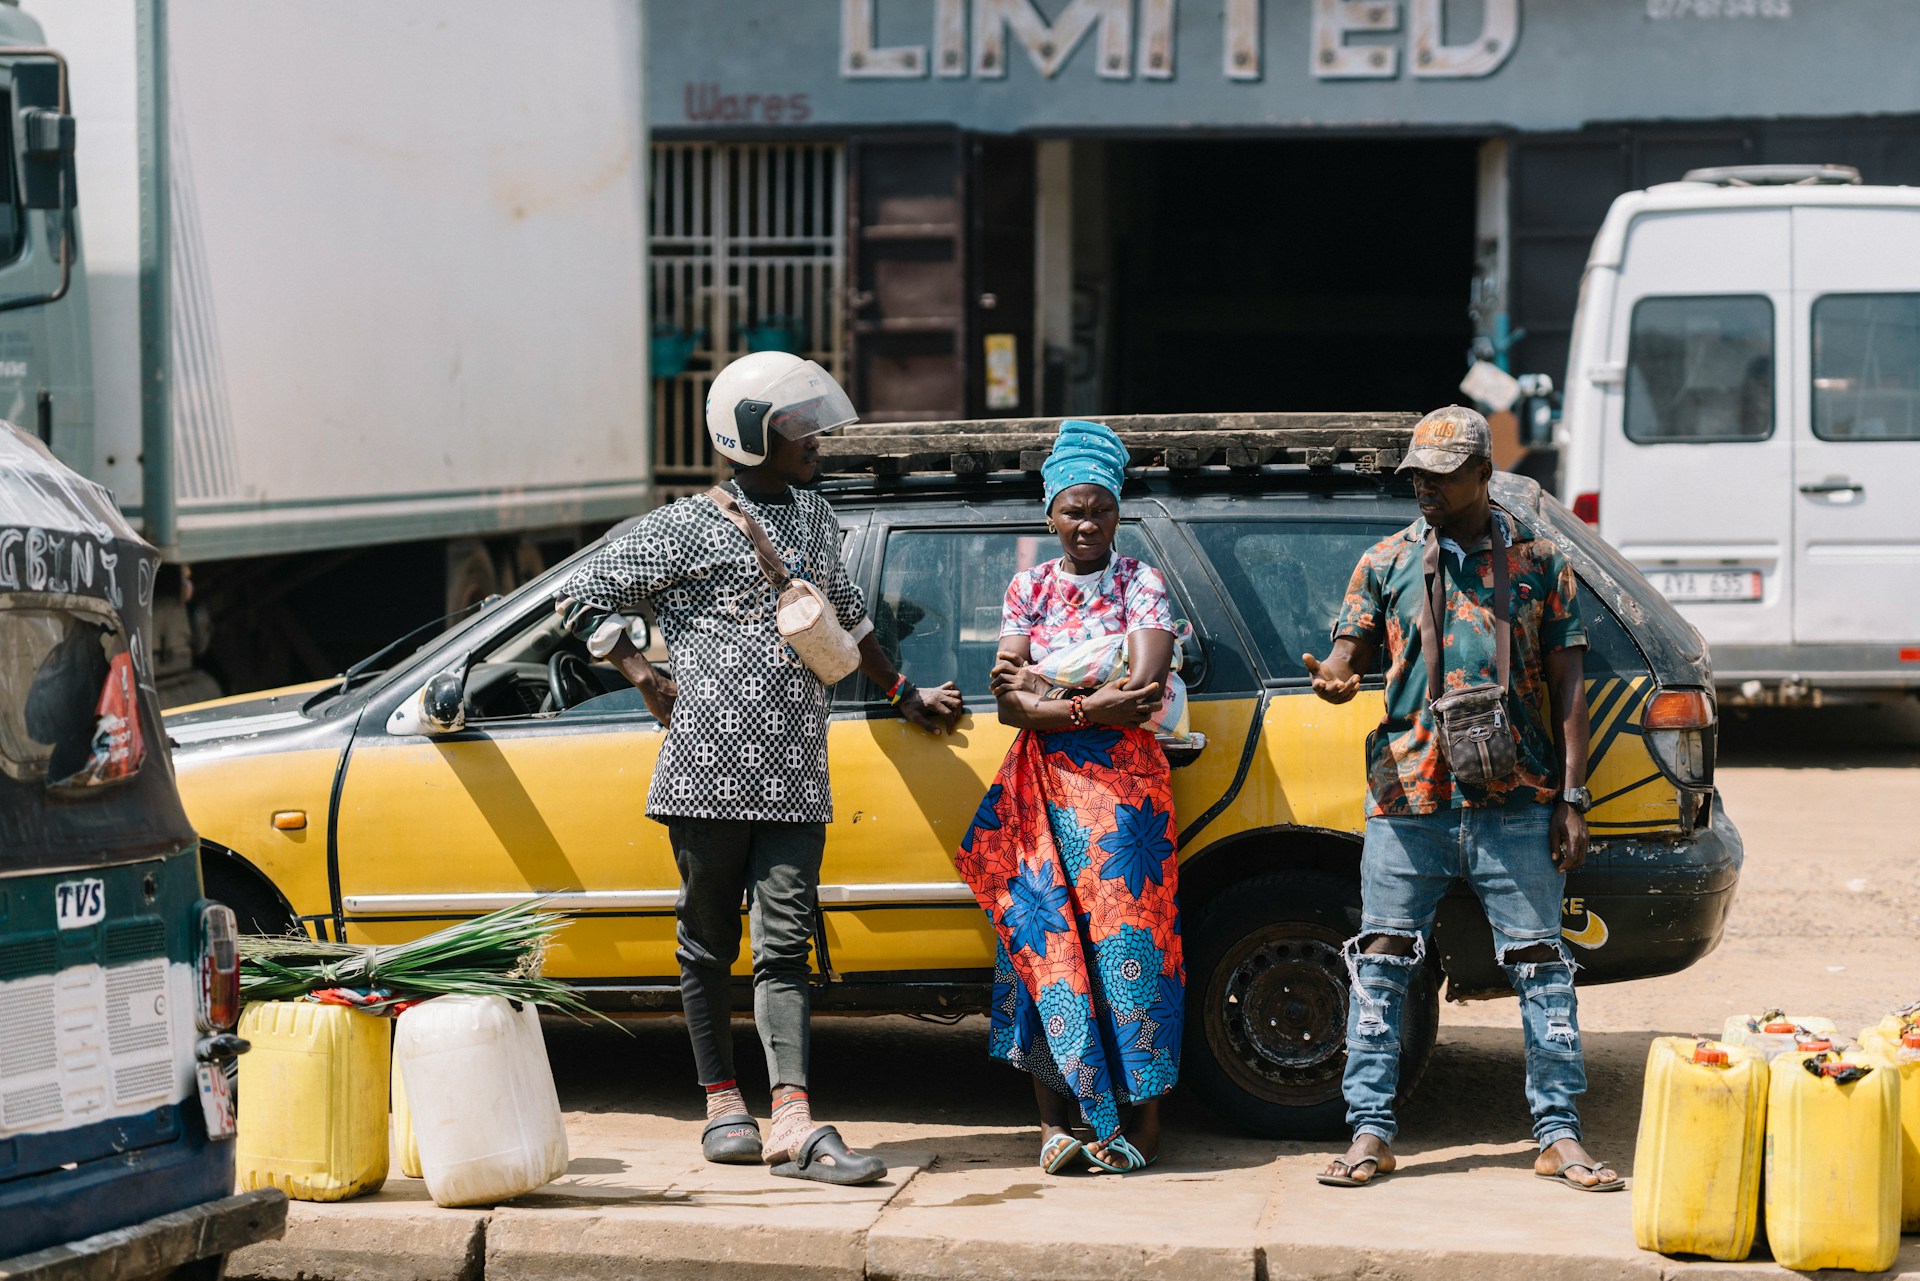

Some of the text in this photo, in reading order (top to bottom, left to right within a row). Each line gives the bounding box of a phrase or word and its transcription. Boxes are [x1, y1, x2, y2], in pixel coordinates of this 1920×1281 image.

[685, 81, 813, 122] Wares
[716, 433, 736, 449] TVS
[58, 882, 101, 917] TVS
